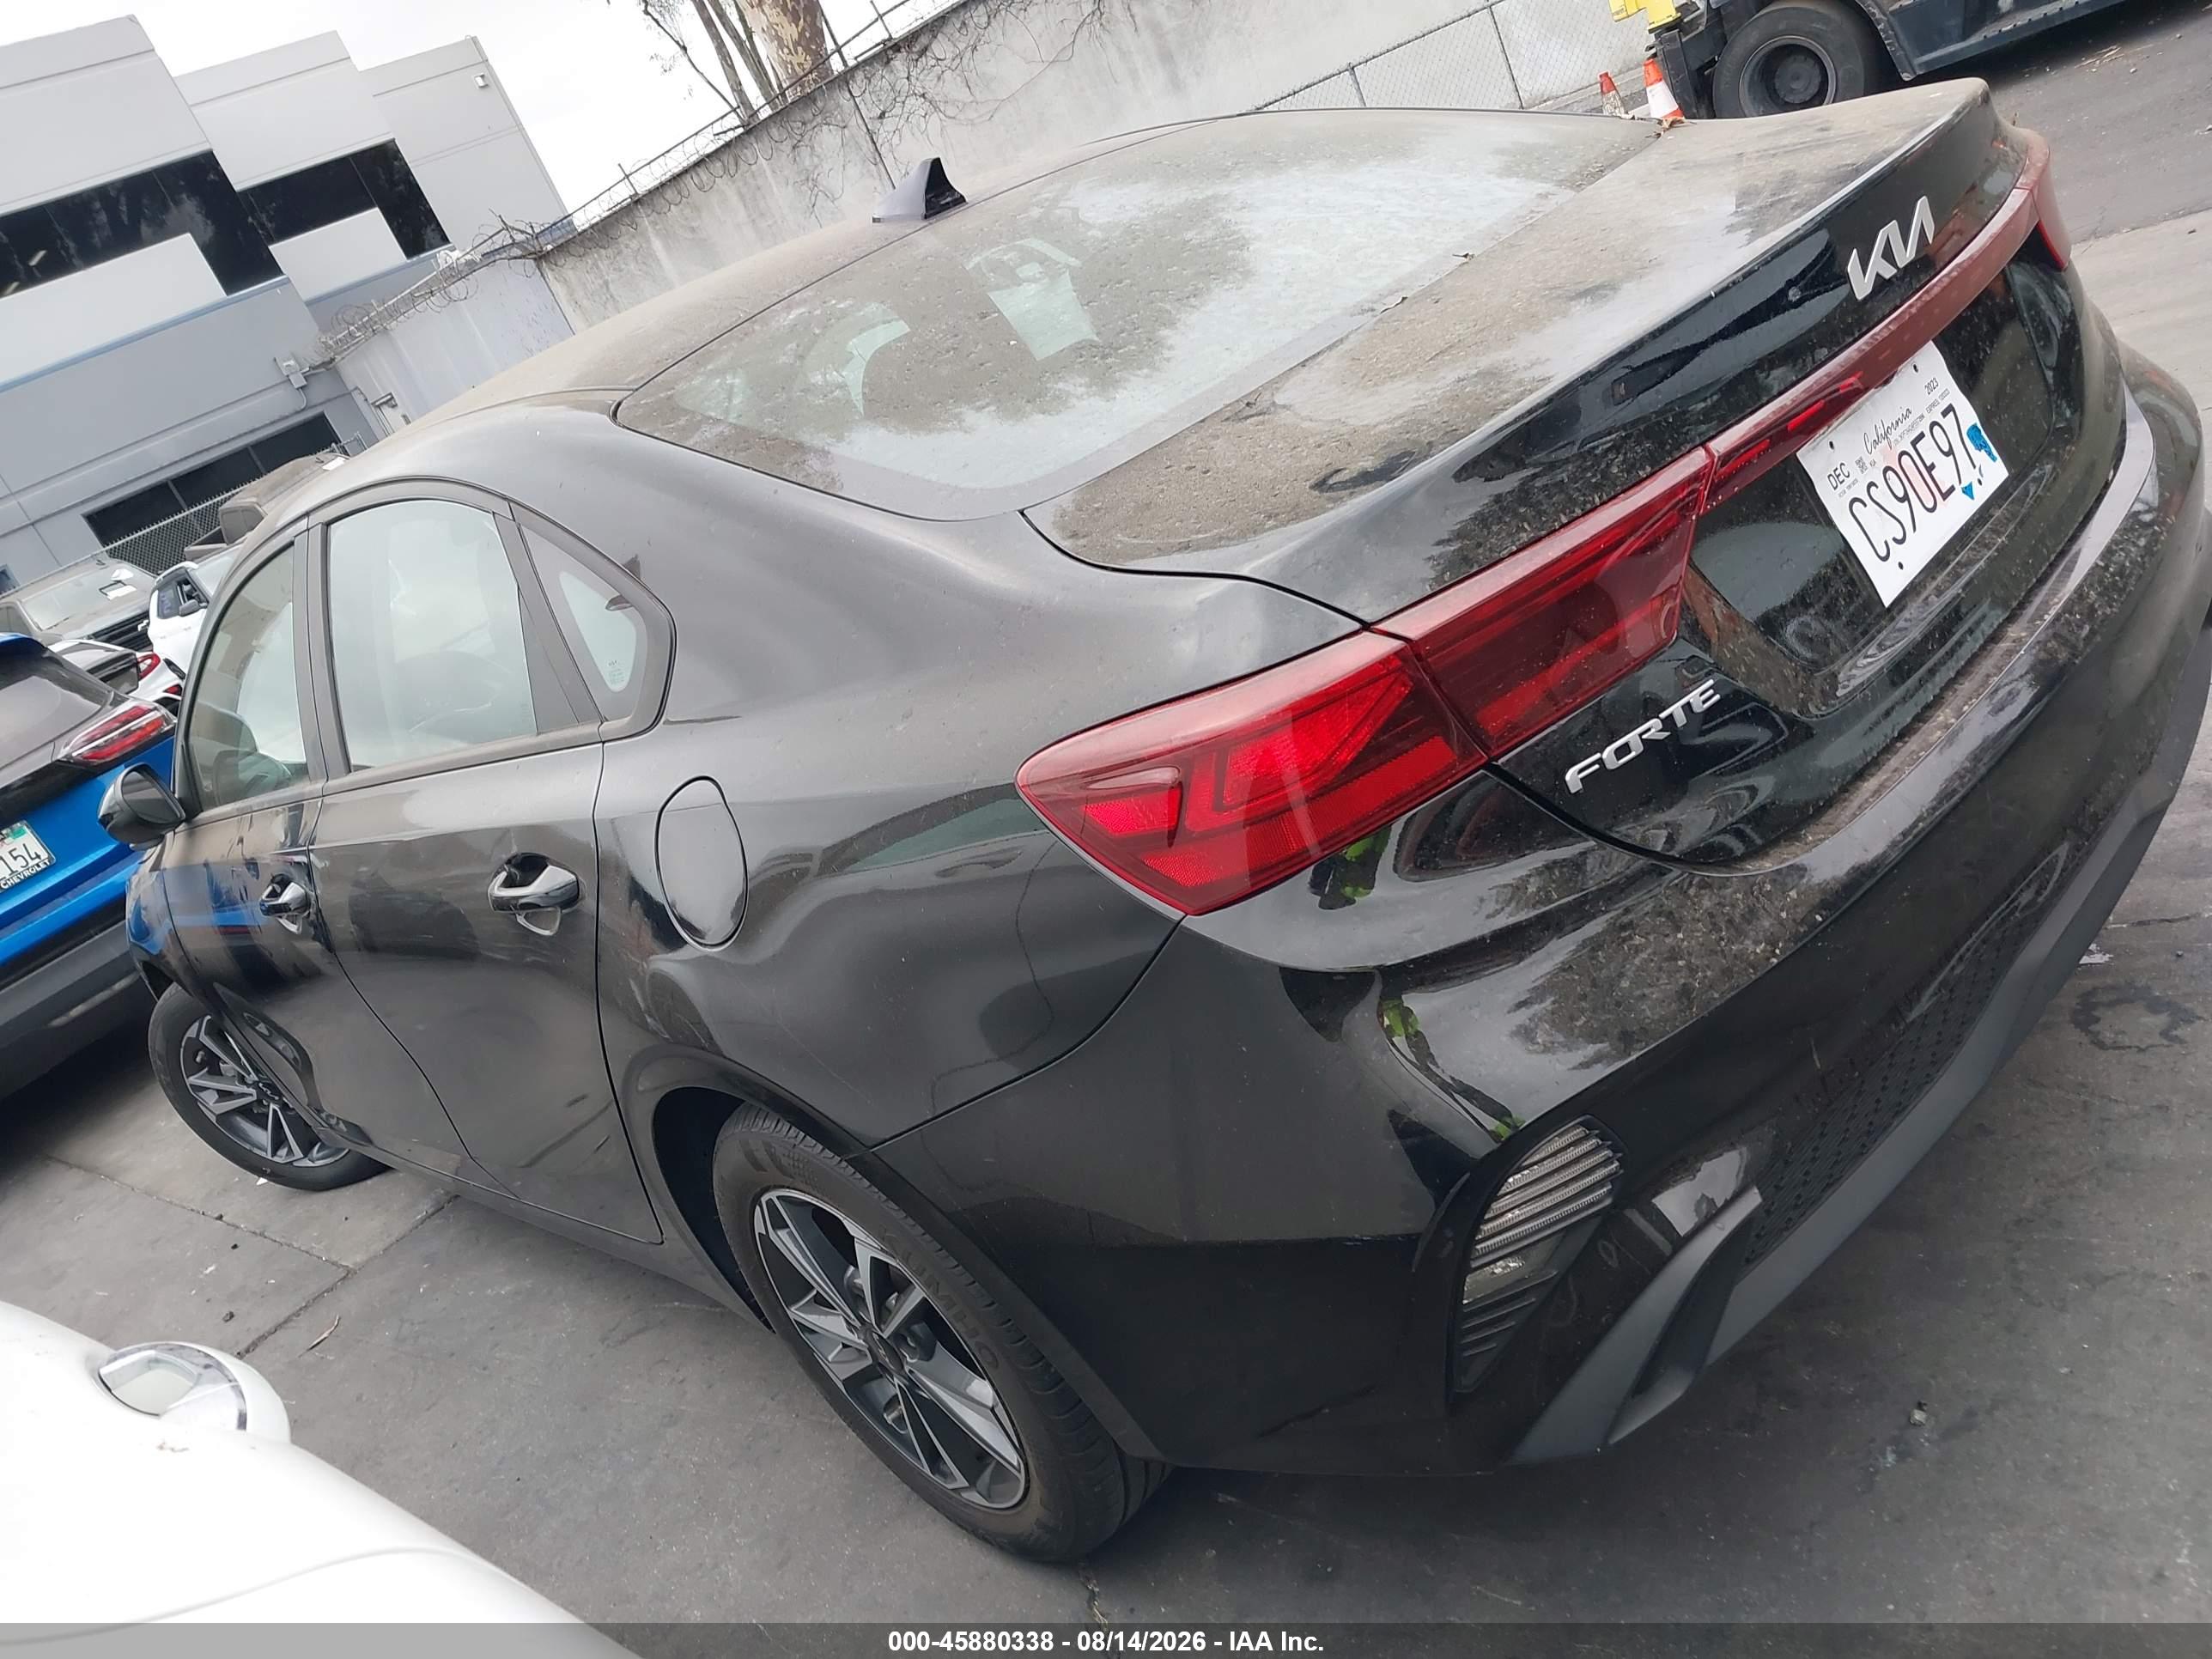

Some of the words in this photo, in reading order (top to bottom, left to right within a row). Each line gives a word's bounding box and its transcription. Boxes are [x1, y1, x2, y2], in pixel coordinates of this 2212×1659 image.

[1848, 196, 1935, 300] KIA
[1925, 378, 1939, 395] 2023
[1863, 405, 1912, 455] California
[1827, 462, 1850, 490] DEC
[1848, 403, 1976, 562] CS90E97
[1565, 678, 1721, 793] FORTE
[0, 843, 42, 879] 154
[0, 860, 51, 890] CHEVROLET
